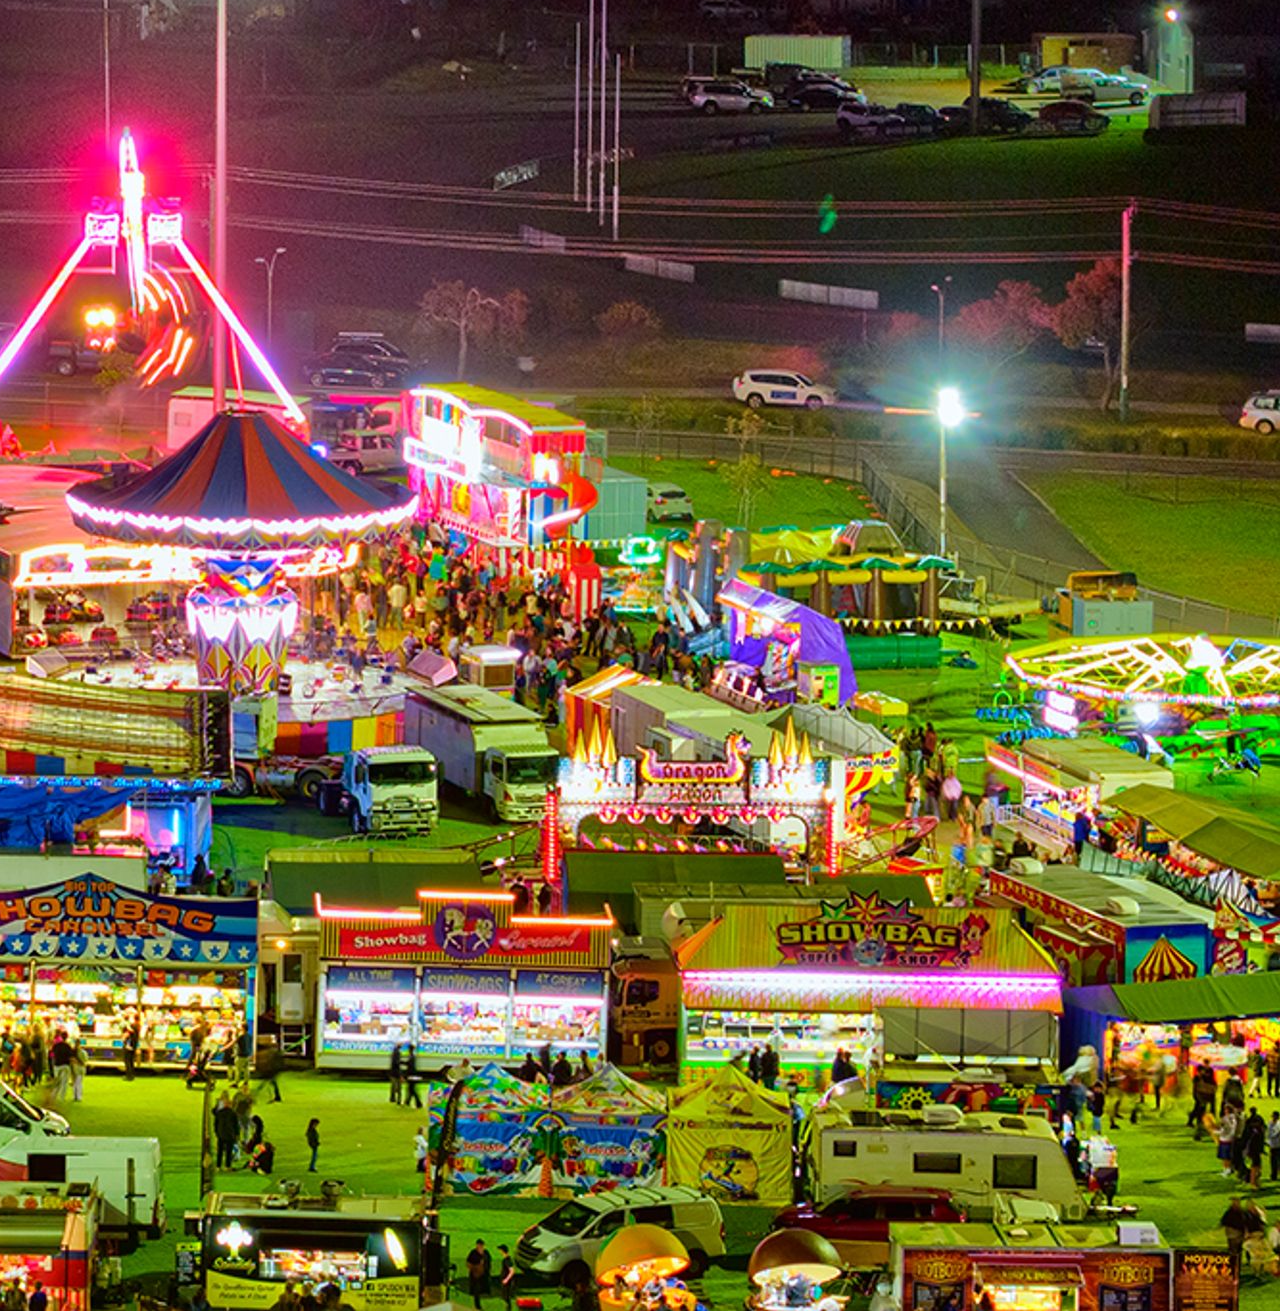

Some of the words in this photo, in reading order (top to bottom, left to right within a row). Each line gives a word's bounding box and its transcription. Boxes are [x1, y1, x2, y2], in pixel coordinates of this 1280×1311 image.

[847, 756, 897, 767] FUNLAND
[662, 763, 729, 784] Dragon
[669, 788, 723, 804] Wagon
[65, 881, 87, 892] BIG
[90, 882, 116, 893] TOP
[25, 919, 165, 937] CAROUSEL
[780, 919, 957, 947] SHOWBAG
[355, 933, 427, 950] Showbag
[799, 952, 840, 963] SUPER
[899, 953, 939, 963] SHOP
[347, 970, 365, 982] ALL
[369, 969, 394, 981] TIME
[535, 974, 549, 983] AT
[551, 974, 586, 987] GREAT
[427, 974, 504, 992] SHOWBAGS
[427, 1043, 497, 1055] SHOWBAGS
[1184, 1255, 1231, 1265] HOTBOX
